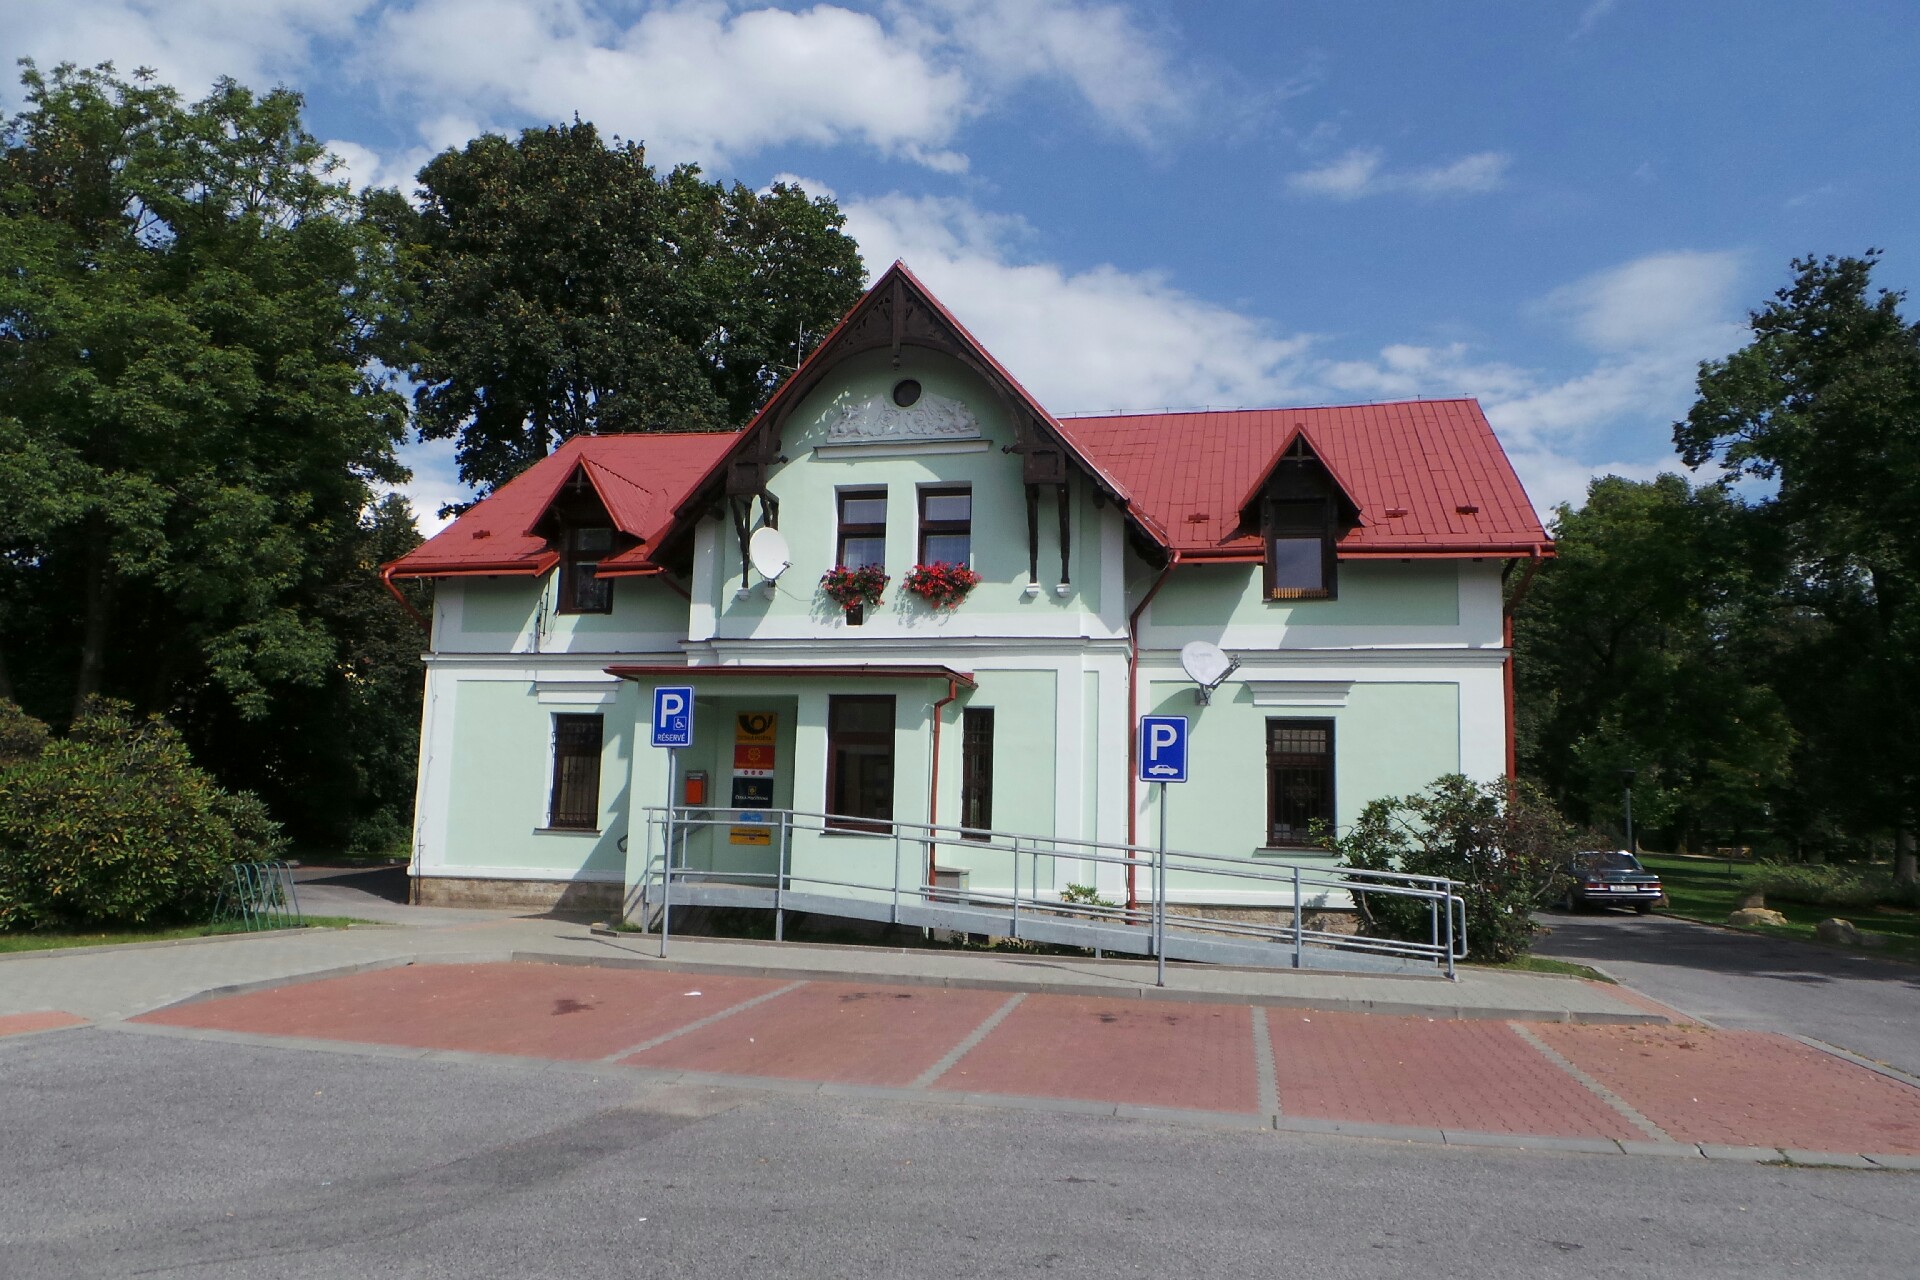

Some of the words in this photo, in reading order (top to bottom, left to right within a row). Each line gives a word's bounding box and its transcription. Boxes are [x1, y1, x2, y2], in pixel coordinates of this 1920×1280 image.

[661, 694, 683, 728] P
[657, 732, 686, 742] RÉSERVÉ
[1151, 724, 1177, 760] P
